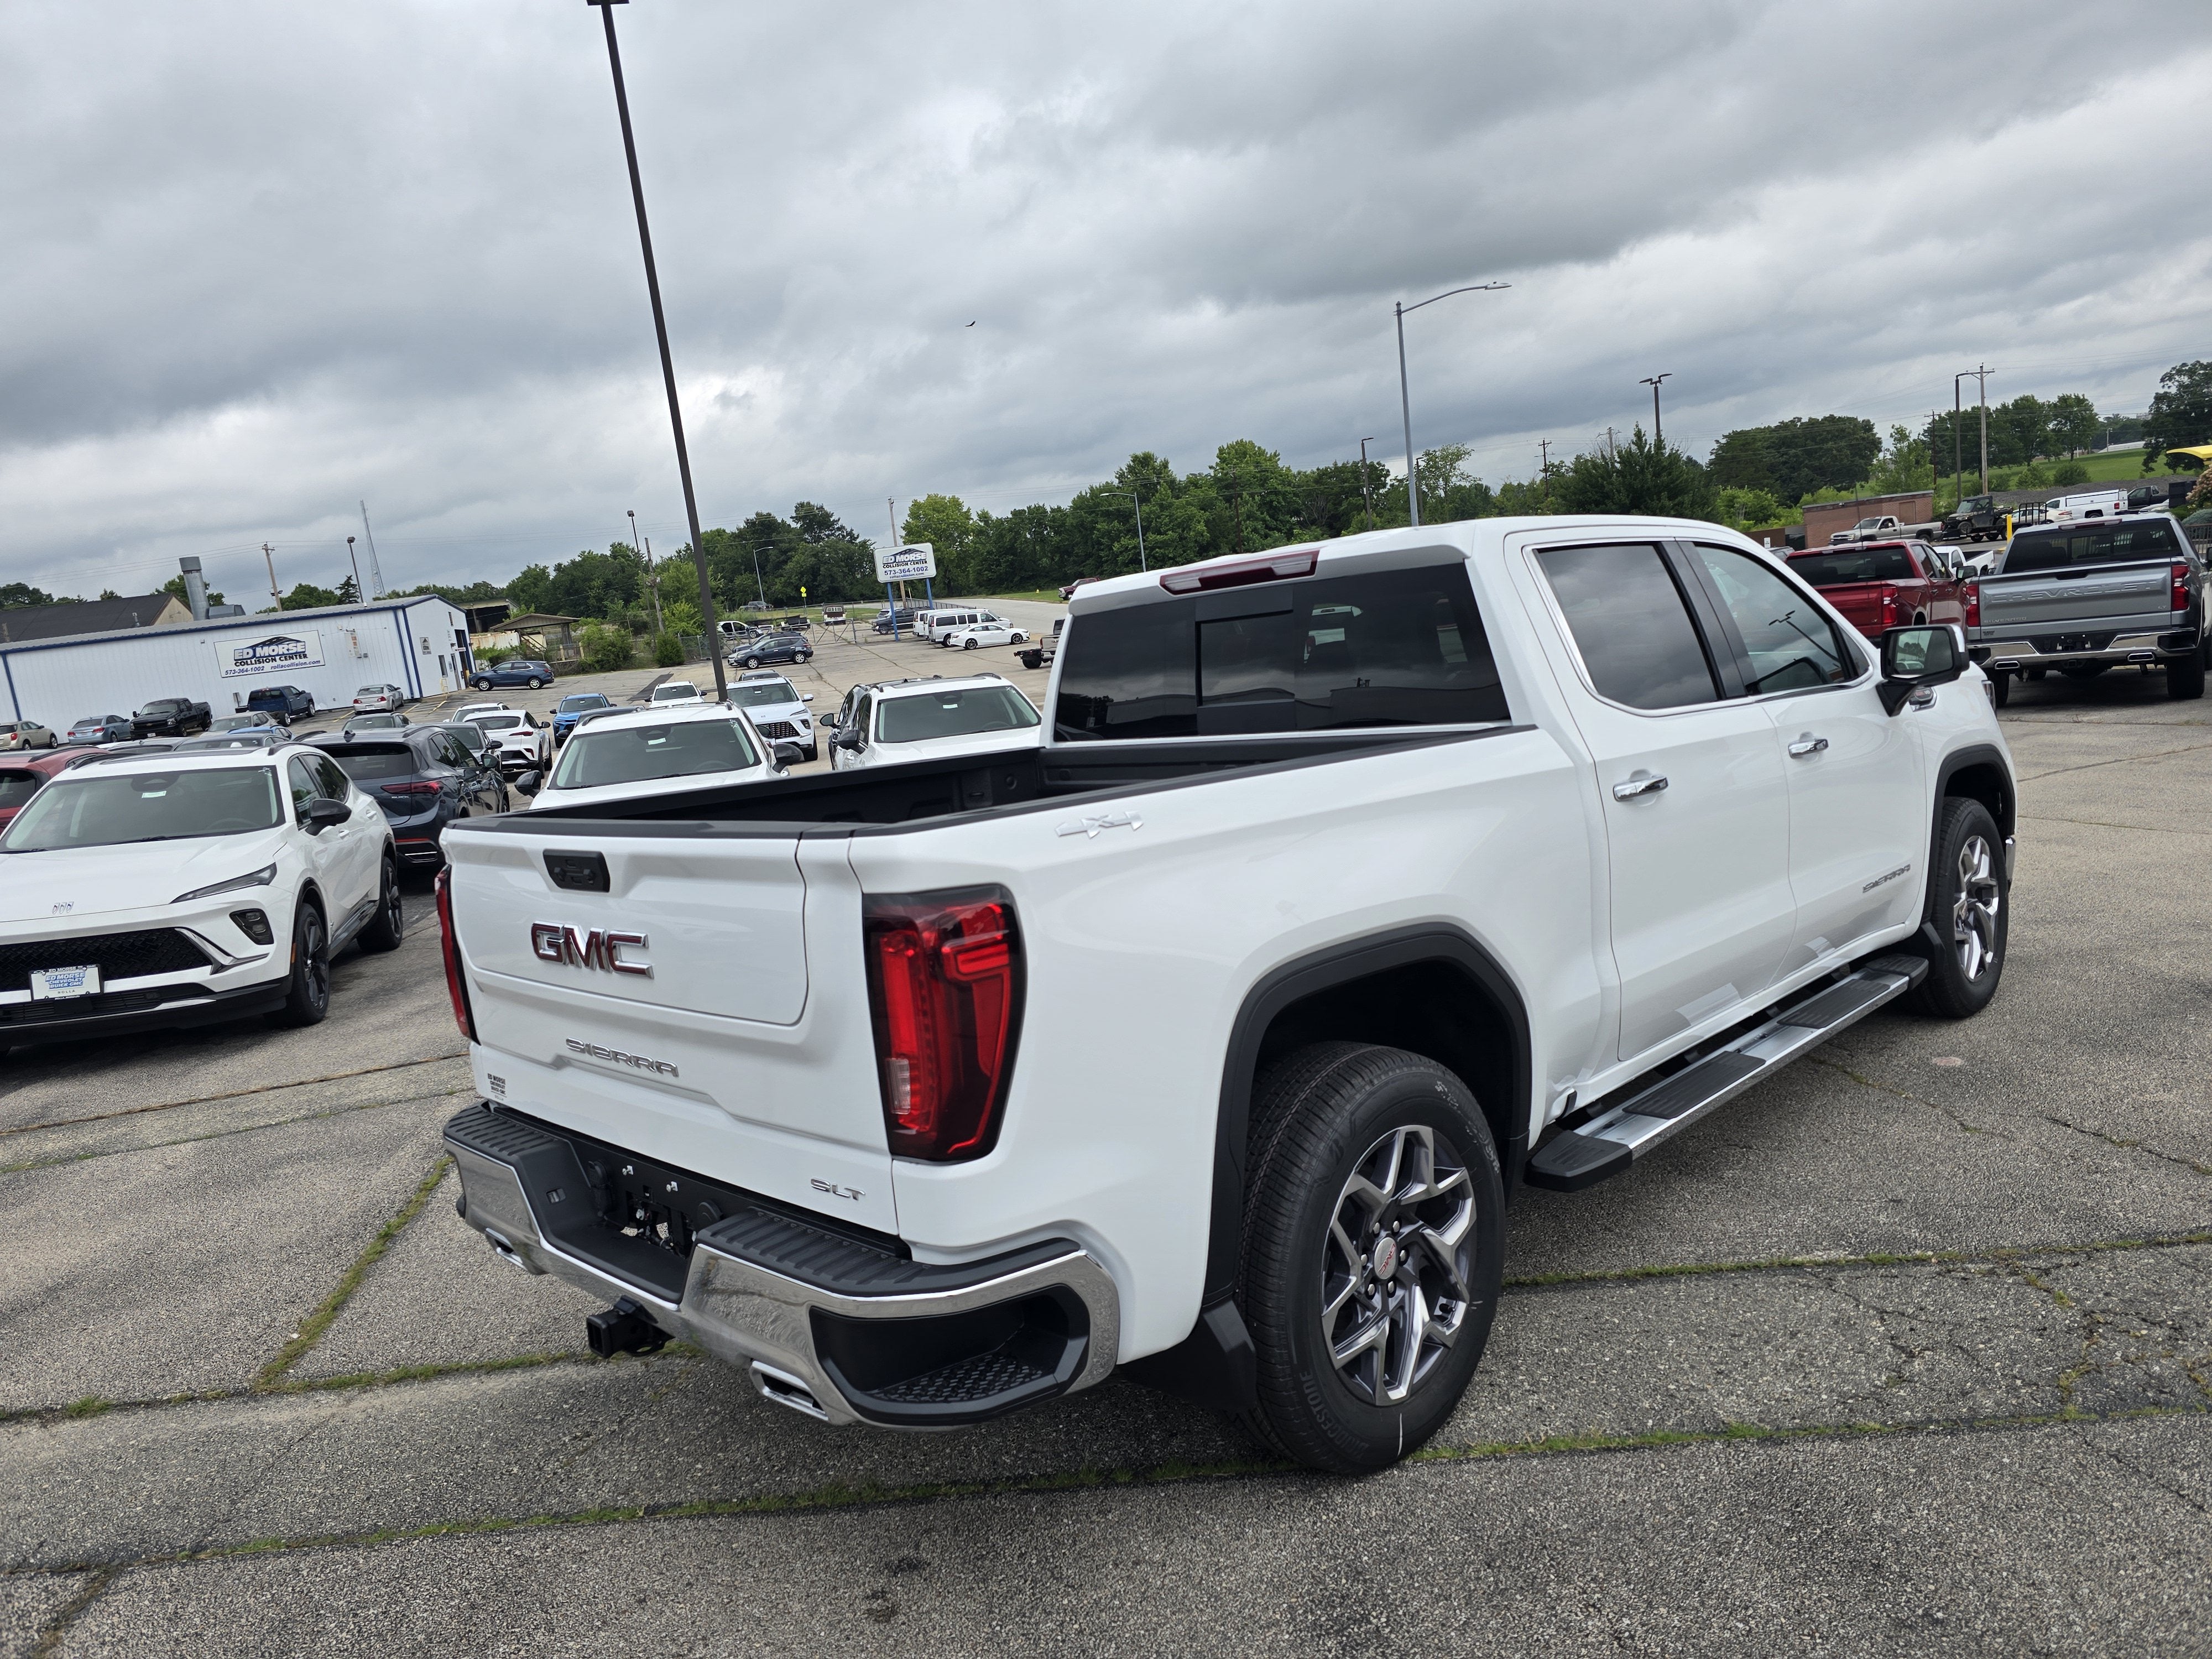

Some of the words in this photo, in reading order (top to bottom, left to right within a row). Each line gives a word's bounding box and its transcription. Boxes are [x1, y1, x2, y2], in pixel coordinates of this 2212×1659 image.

[896, 552, 926, 562] MORSE
[884, 566, 928, 576] 573-364-1002
[1991, 581, 2157, 603] CHEVROLET
[234, 648, 253, 660] ED
[255, 642, 305, 658] MORSE
[234, 657, 276, 667] COLLISION
[279, 653, 309, 662] CENTER
[225, 666, 265, 675] 573-364-1002
[270, 660, 321, 670] rollacollision.com
[1863, 864, 1911, 893] SIERRA
[531, 920, 654, 979] GMC
[566, 1037, 679, 1077] SIERRA
[811, 1178, 865, 1201] SLT
[1378, 1243, 1396, 1275] GMC
[1300, 1371, 1370, 1458] BRIDGESTONE
